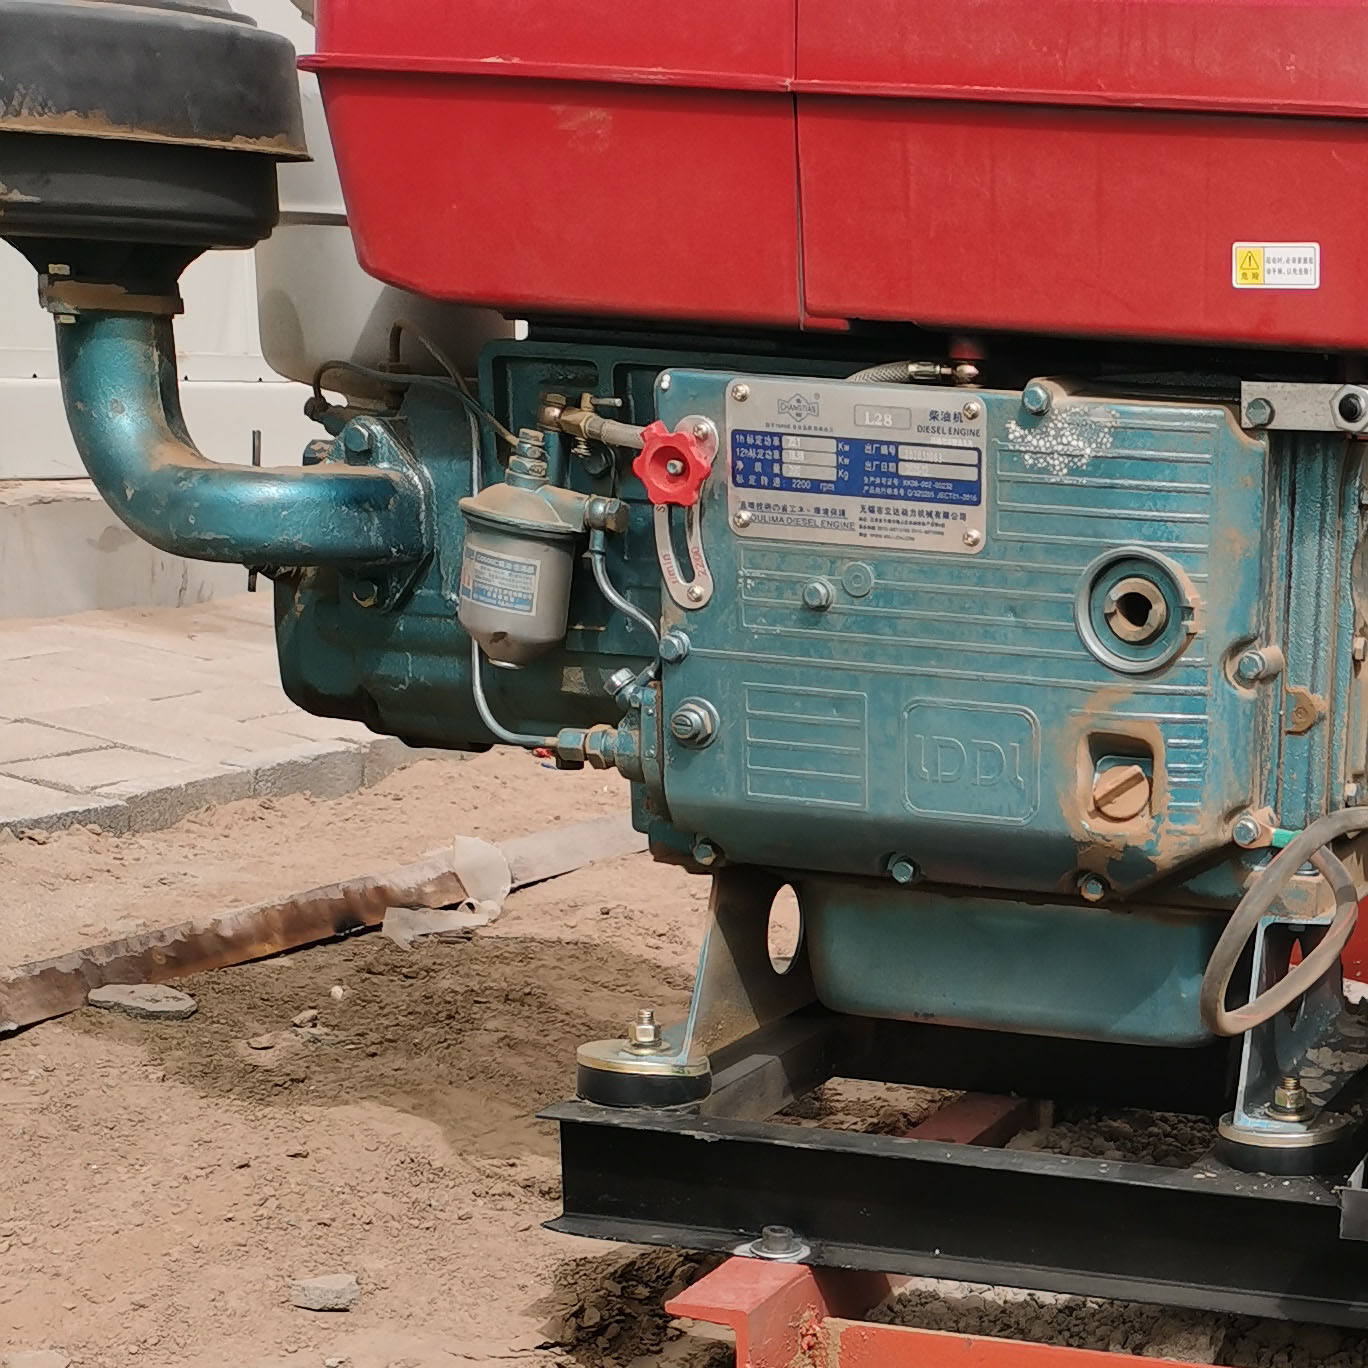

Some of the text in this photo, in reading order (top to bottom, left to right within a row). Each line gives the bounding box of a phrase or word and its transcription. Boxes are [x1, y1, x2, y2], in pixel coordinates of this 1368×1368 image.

[865, 411, 893, 427] L28
[929, 410, 964, 423] 柴油机
[917, 425, 981, 437] DIESEL ENGINE
[791, 479, 811, 489] 2200
[786, 516, 819, 528] DIESEL
[820, 519, 856, 530] ENGINE
